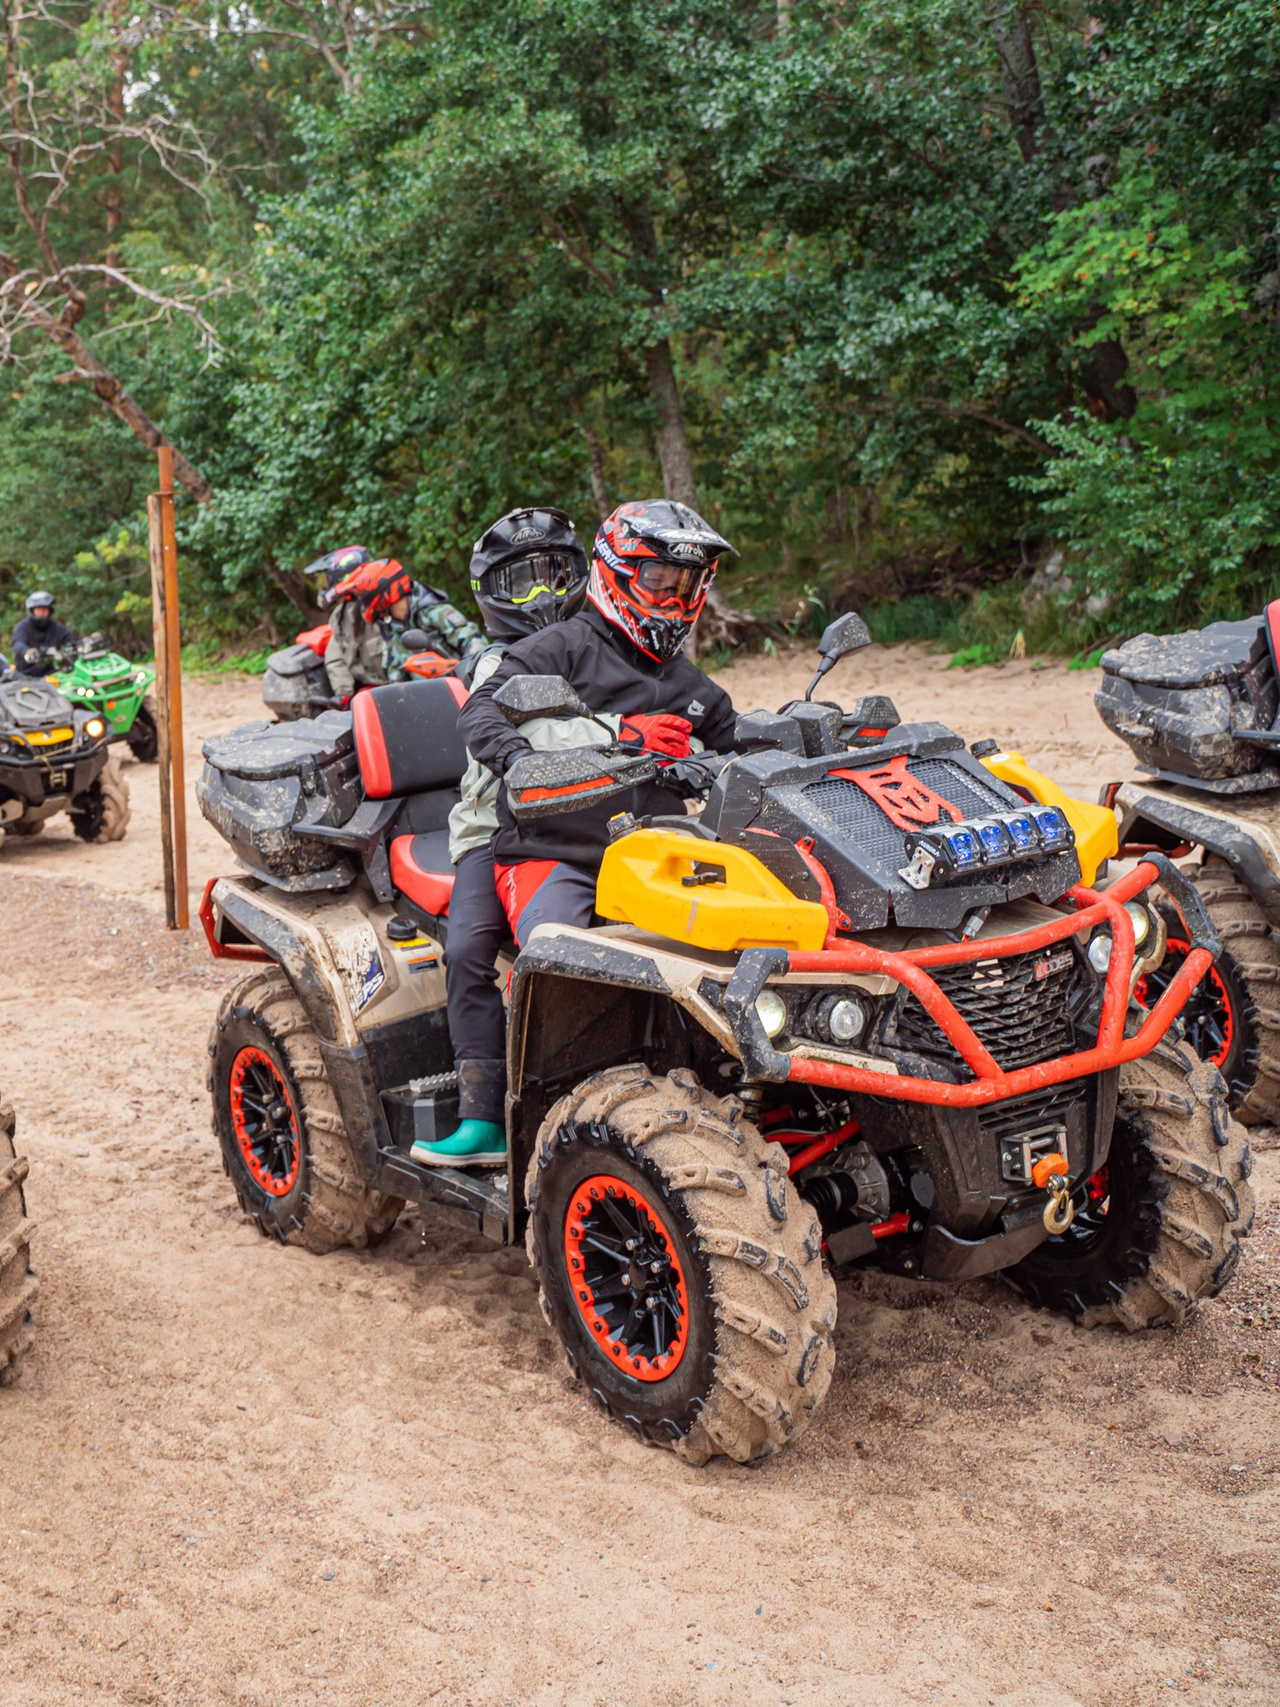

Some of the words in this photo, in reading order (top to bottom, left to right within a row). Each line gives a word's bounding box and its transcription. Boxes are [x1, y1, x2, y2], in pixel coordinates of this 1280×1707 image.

[596, 538, 627, 569] LEATT
[672, 543, 704, 558] Airoh
[919, 840, 940, 858] AURORA
